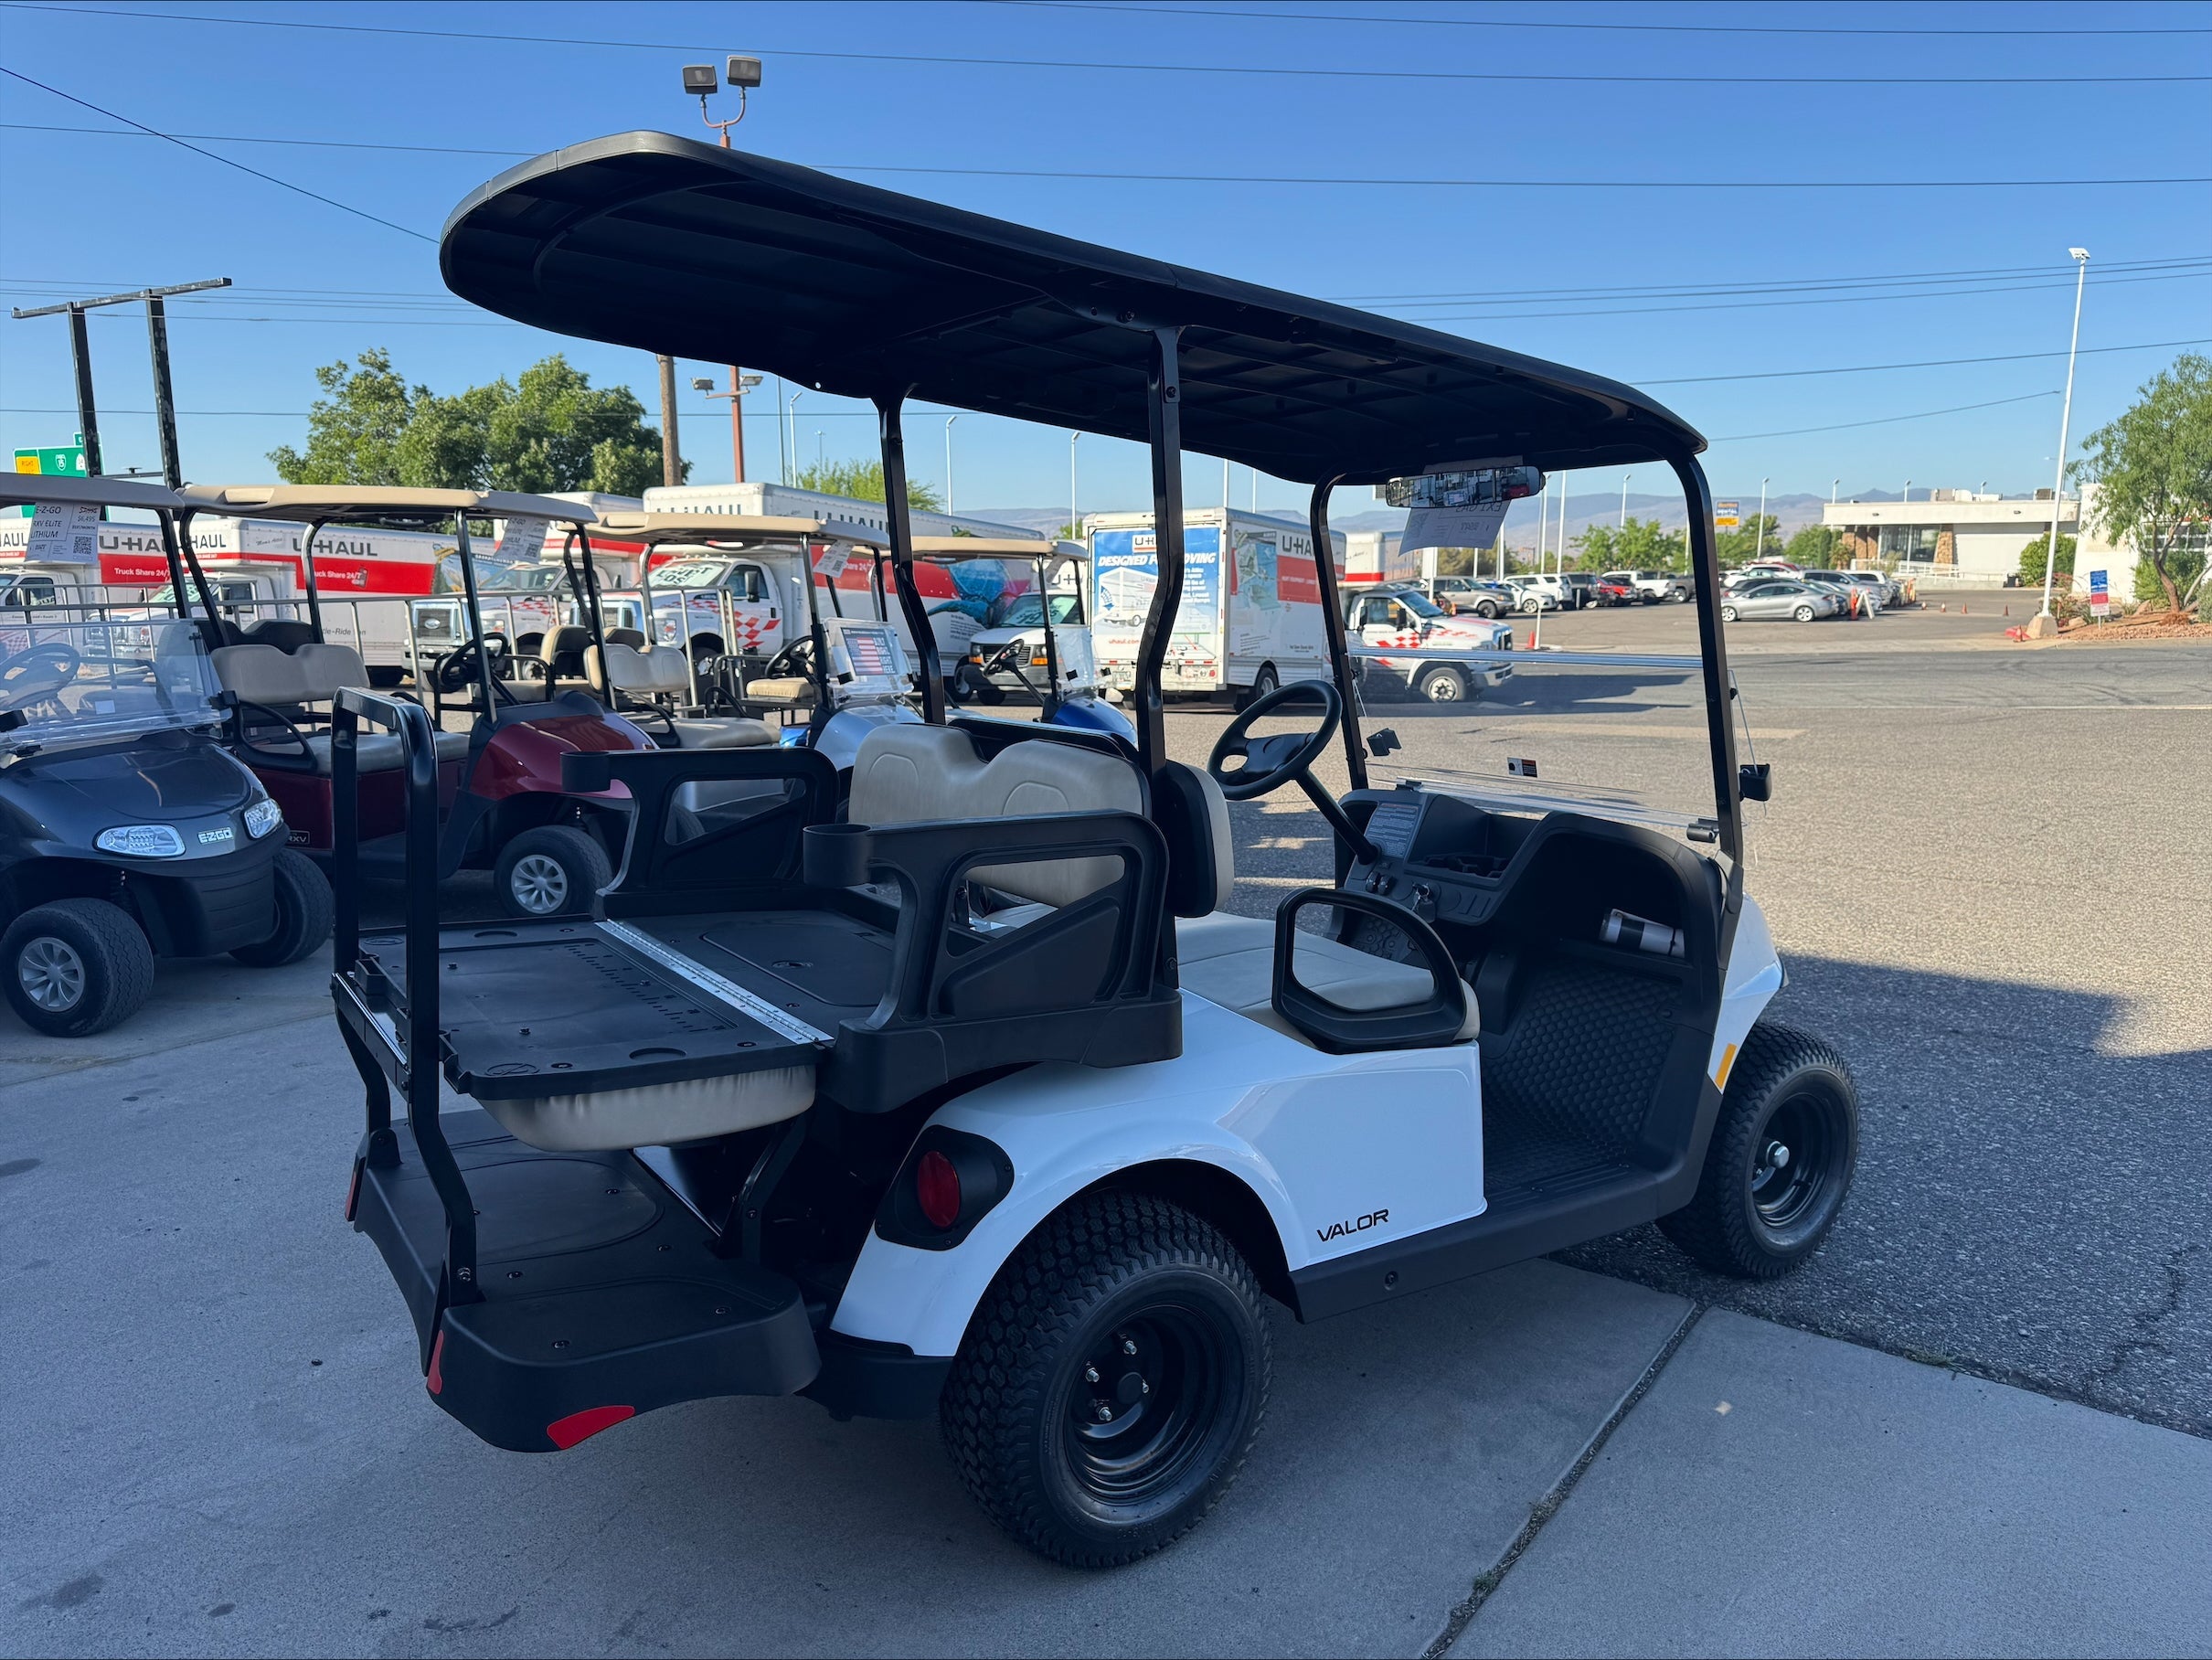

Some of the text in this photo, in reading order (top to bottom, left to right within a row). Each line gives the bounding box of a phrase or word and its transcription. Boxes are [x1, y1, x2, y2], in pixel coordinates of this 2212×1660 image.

[0, 532, 28, 547] AUL
[99, 536, 167, 552] U-HA
[190, 534, 227, 548] HAUL
[1282, 535, 1314, 557] U-HA
[1098, 555, 1148, 567] DESIGNED
[1185, 552, 1217, 564] OVING
[114, 567, 134, 575] Truck
[135, 568, 155, 576] Share
[314, 569, 362, 580] uck Share 24/7
[1316, 1208, 1389, 1242] VALOR
